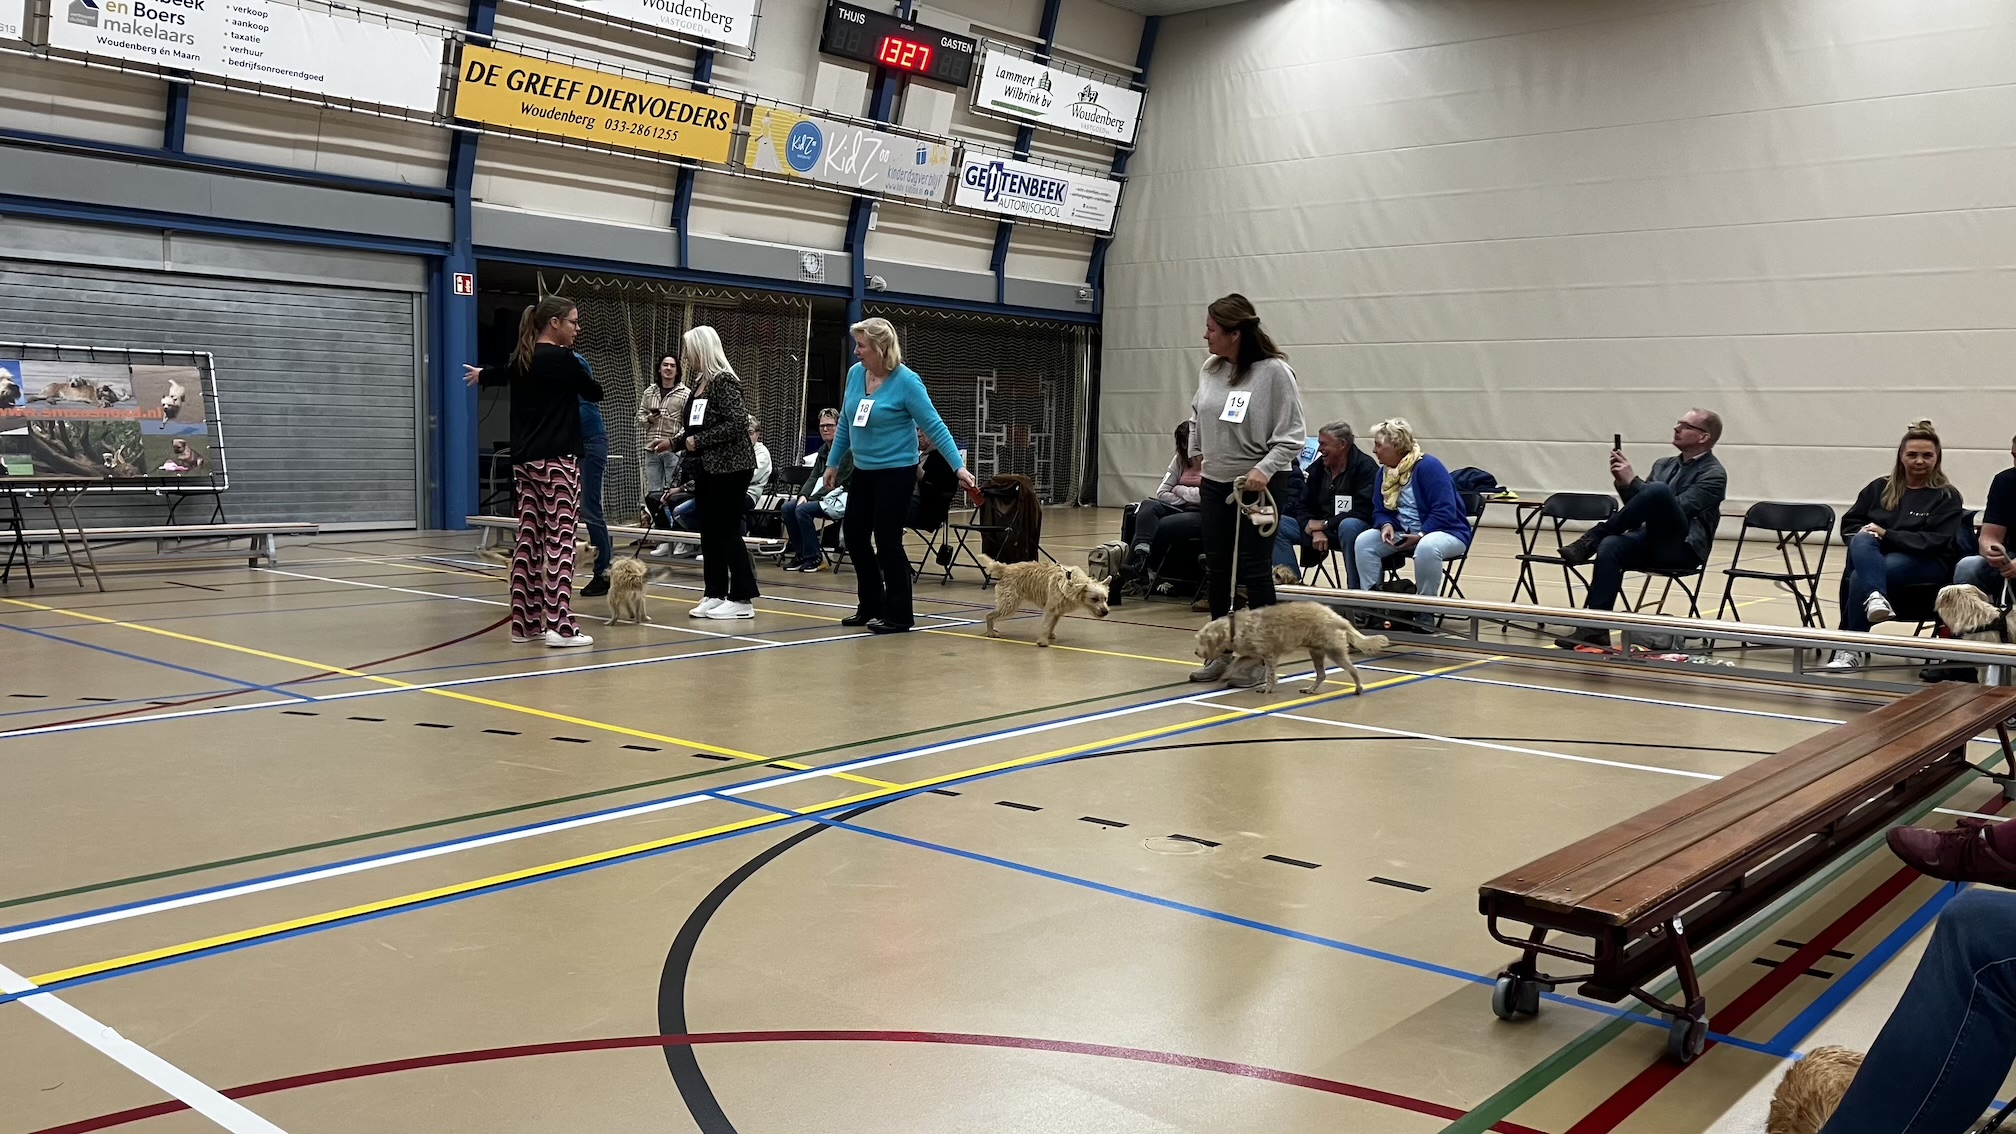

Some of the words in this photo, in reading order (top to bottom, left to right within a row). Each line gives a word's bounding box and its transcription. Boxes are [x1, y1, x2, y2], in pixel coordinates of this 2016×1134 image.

[105, 0, 128, 15] en
[133, 1, 186, 25] Boers
[232, 5, 269, 19] verkoop
[838, 8, 866, 25] THUIS
[104, 19, 195, 45] makelaars
[231, 19, 270, 33] aankoop
[660, 15, 704, 32] VASTGOED
[230, 31, 261, 44] taxatie
[940, 36, 974, 54] GASTEN
[96, 35, 157, 55] Woudenberg
[159, 47, 171, 56] én
[173, 49, 201, 61] Maarn
[229, 46, 264, 58] verhuur
[880, 37, 930, 71] 1327
[228, 58, 325, 82] bedrijfsonroerendgoed
[995, 65, 1036, 87] Lammert
[465, 60, 502, 87] DE
[506, 69, 584, 101] GREEF
[586, 85, 730, 131] DIERVOEDERS
[1004, 85, 1040, 105] Wilbrink
[1041, 95, 1052, 109] bv
[520, 101, 596, 130] Woudenberg
[604, 118, 679, 142] 033-2861255
[1072, 103, 1125, 133] Woudenberg
[997, 198, 1061, 218] AUTORIJSCHOOL
[694, 403, 704, 413] 17
[860, 403, 870, 414] 18
[1230, 396, 1245, 408] 19
[1337, 499, 1349, 509] 27
